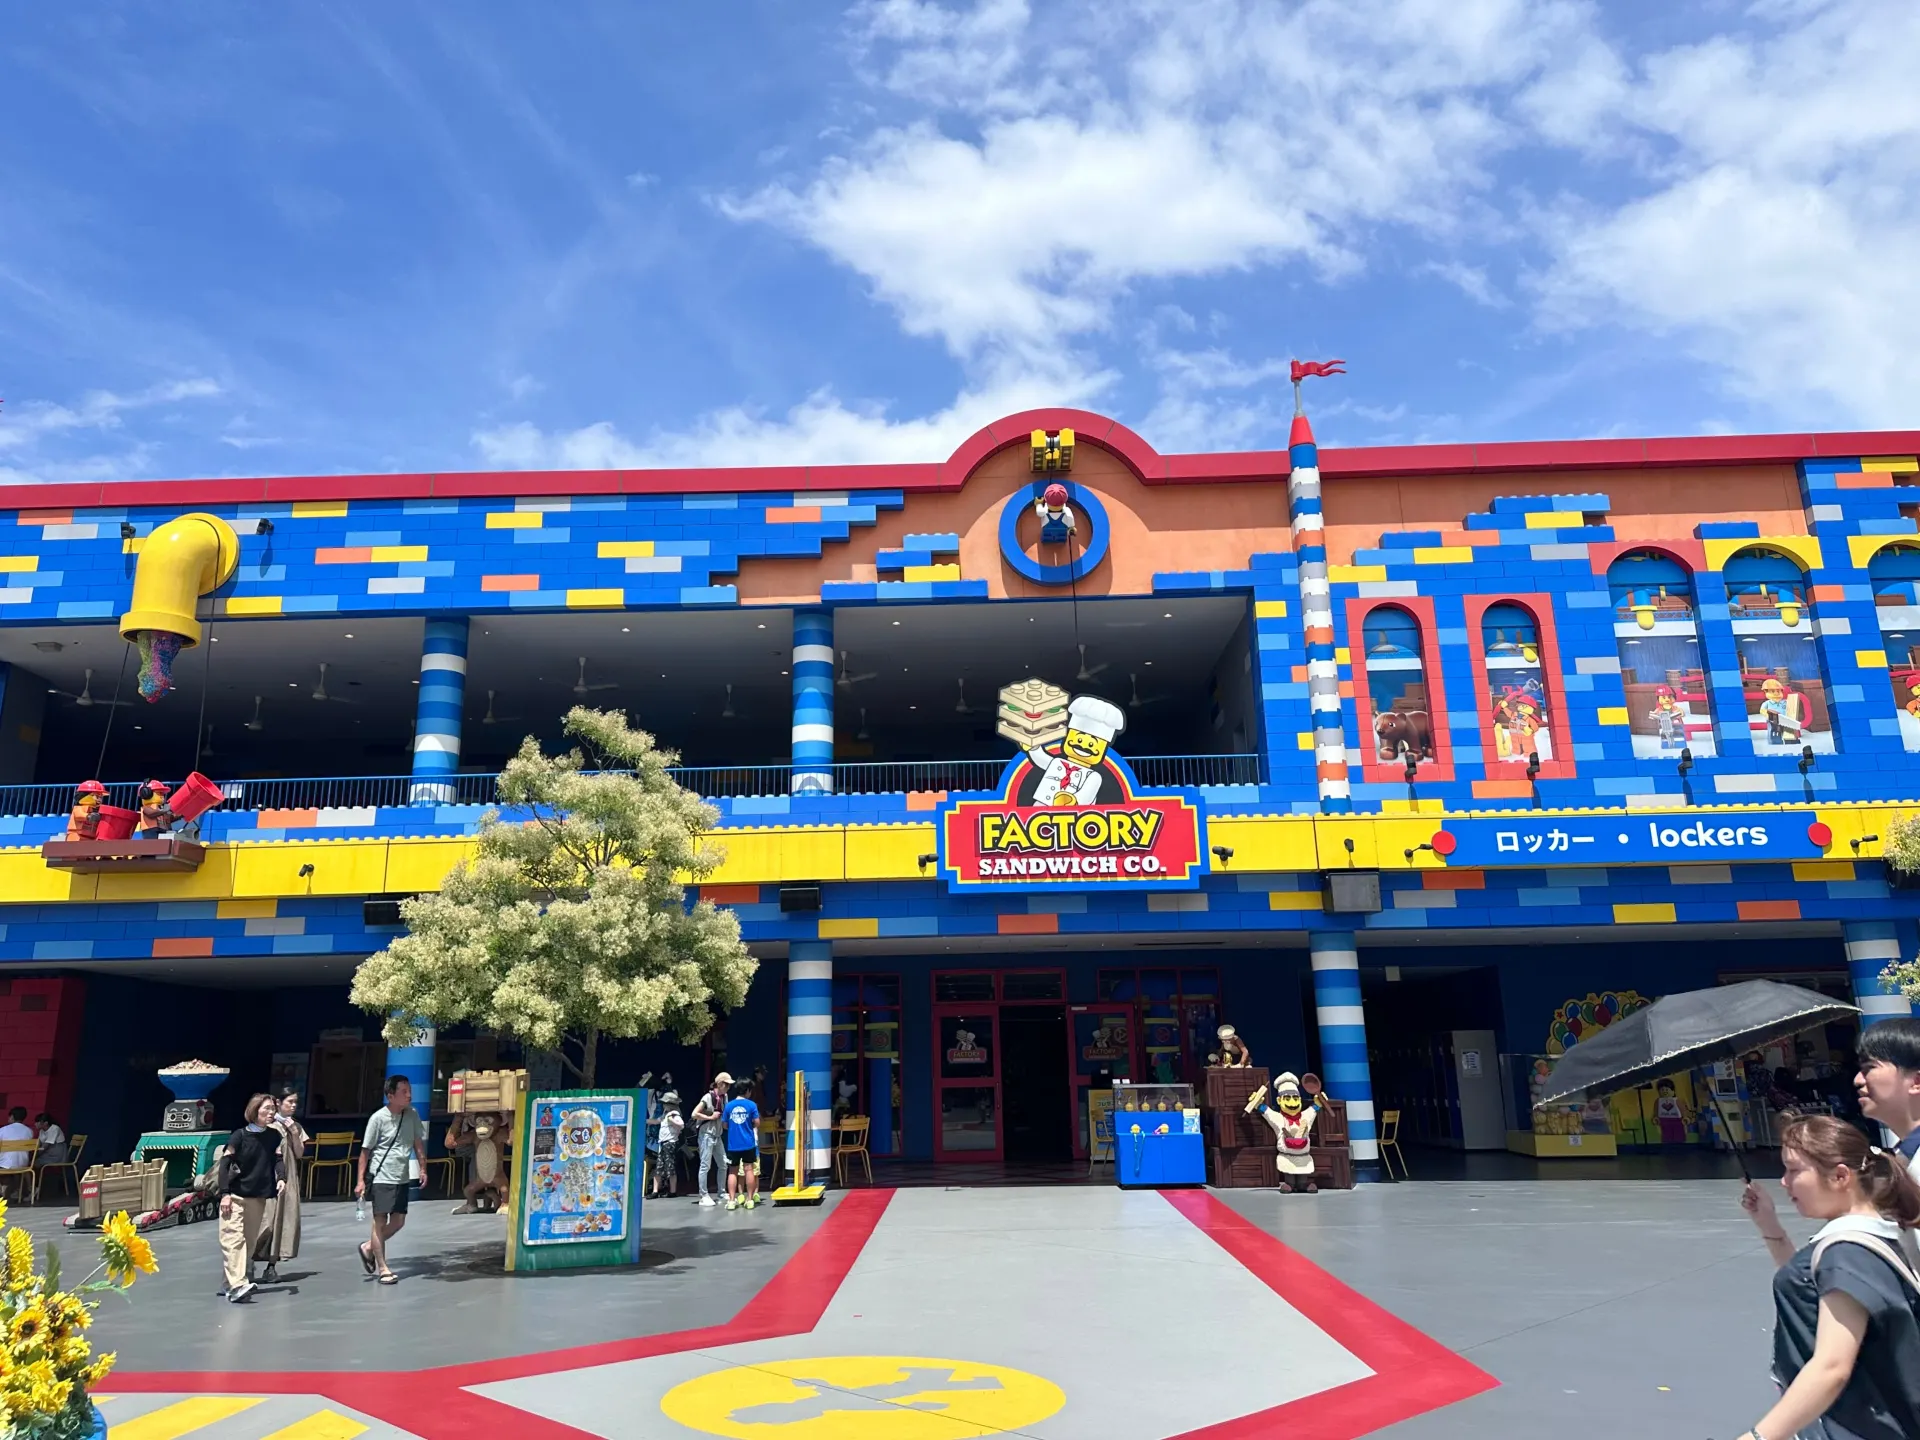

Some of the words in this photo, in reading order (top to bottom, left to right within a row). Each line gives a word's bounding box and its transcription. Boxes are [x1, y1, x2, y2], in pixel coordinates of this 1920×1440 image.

[980, 809, 1163, 853] FACTORY
[1496, 828, 1595, 853] ロッカー
[1649, 821, 1769, 848] lockers
[979, 856, 1118, 876] SANDWICH
[1123, 855, 1167, 873] CO.
